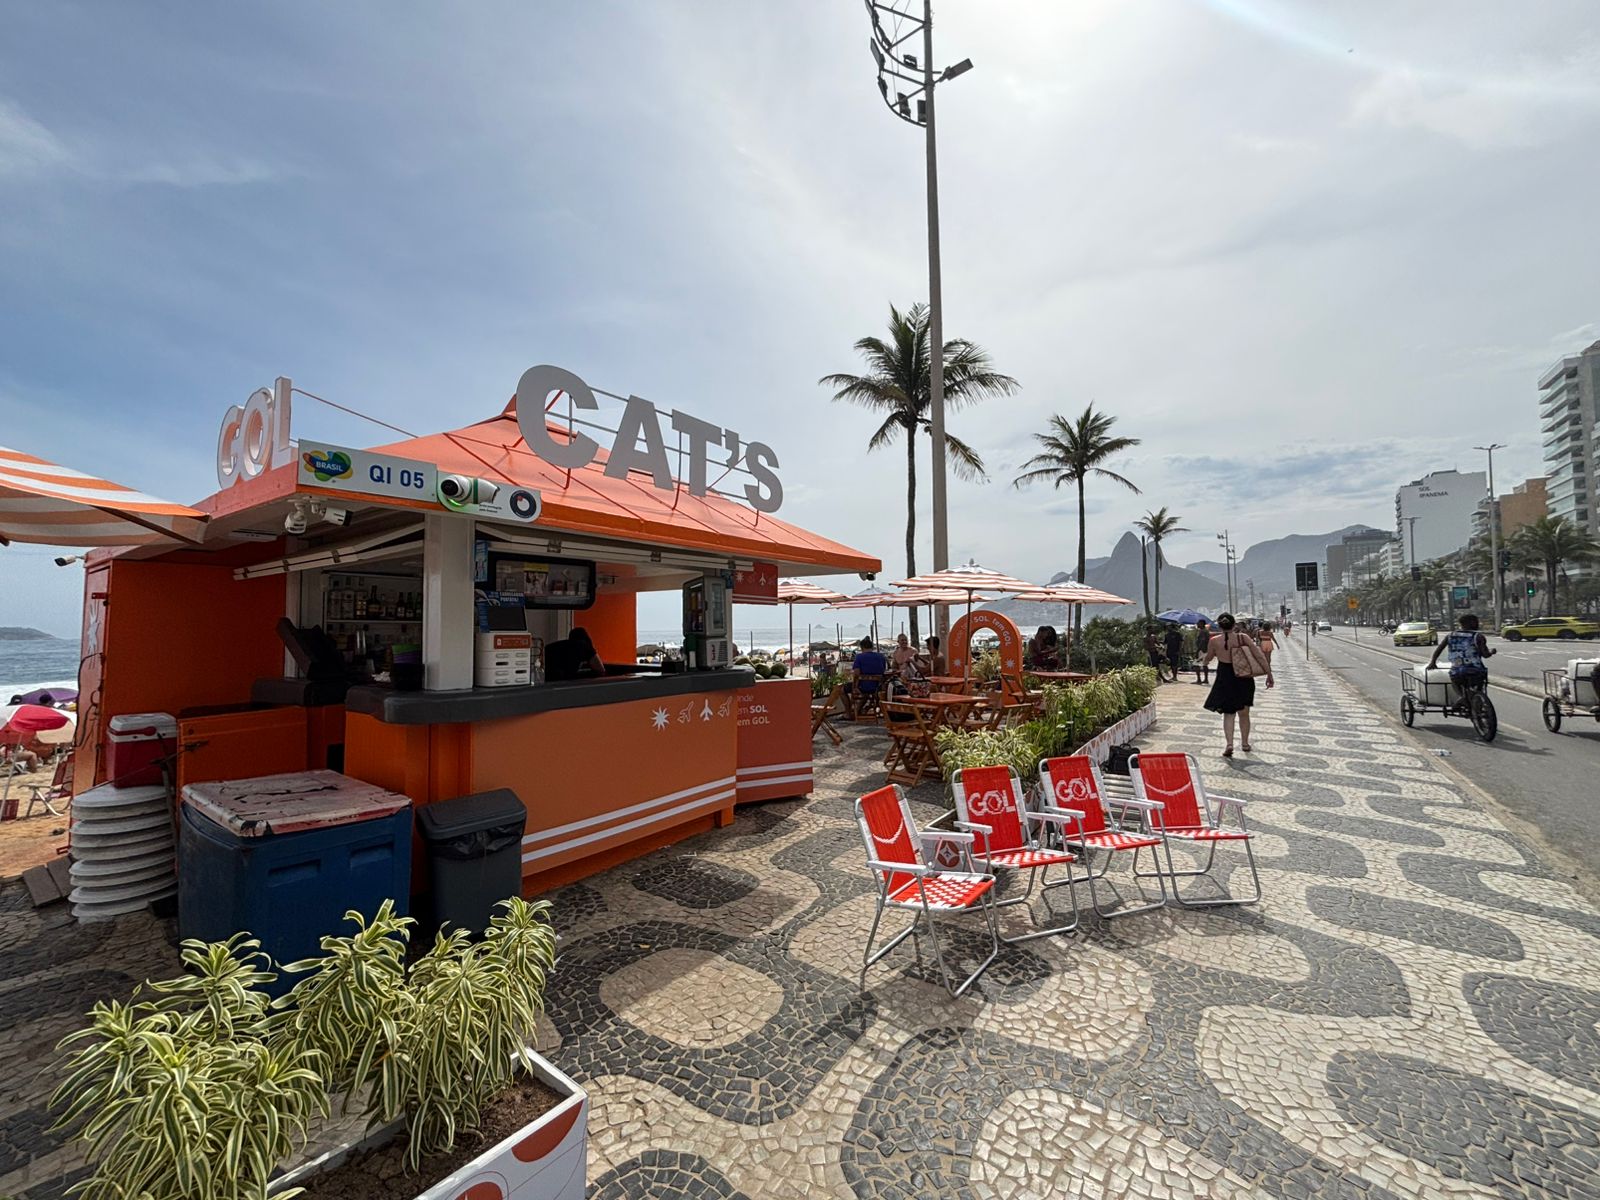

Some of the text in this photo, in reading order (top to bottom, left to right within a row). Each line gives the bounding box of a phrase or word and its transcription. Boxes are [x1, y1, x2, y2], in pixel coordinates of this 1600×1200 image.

[217, 376, 298, 490] GOL
[516, 364, 783, 513] CAT'S
[316, 461, 343, 472] BRASIL
[369, 465, 424, 489] QI 05
[752, 716, 770, 725] GOL
[1055, 777, 1098, 802] GOL
[968, 789, 1016, 816] GOL
